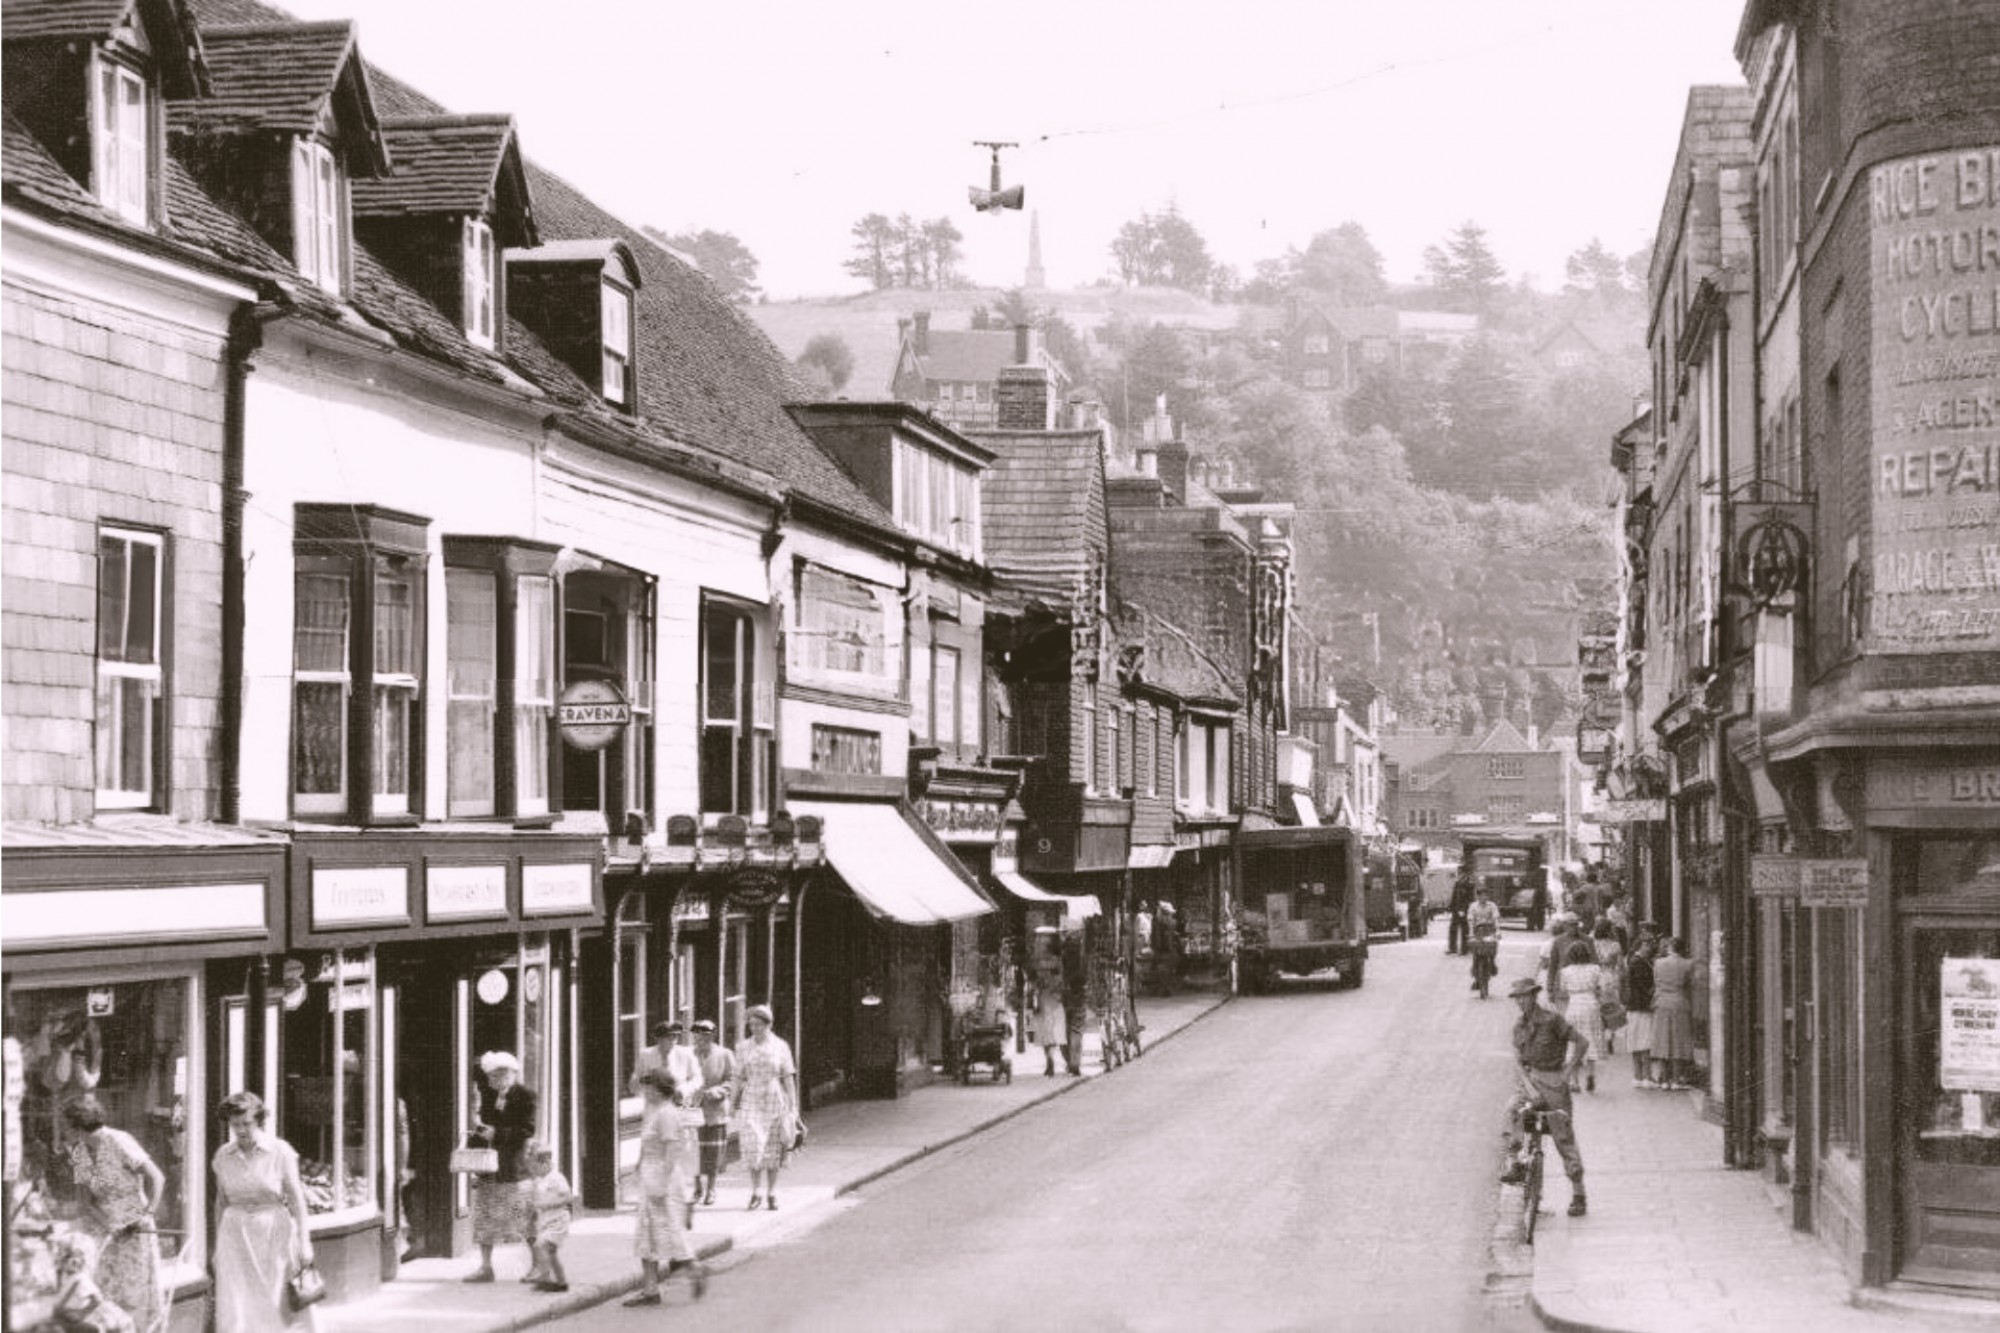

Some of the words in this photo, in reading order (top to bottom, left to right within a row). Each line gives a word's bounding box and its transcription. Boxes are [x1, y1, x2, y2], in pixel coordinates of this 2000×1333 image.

[1872, 158, 1939, 227] RICE
[1901, 286, 2000, 342] CYCL
[1911, 396, 2000, 433] AGEN
[1880, 444, 2000, 498] REPAI
